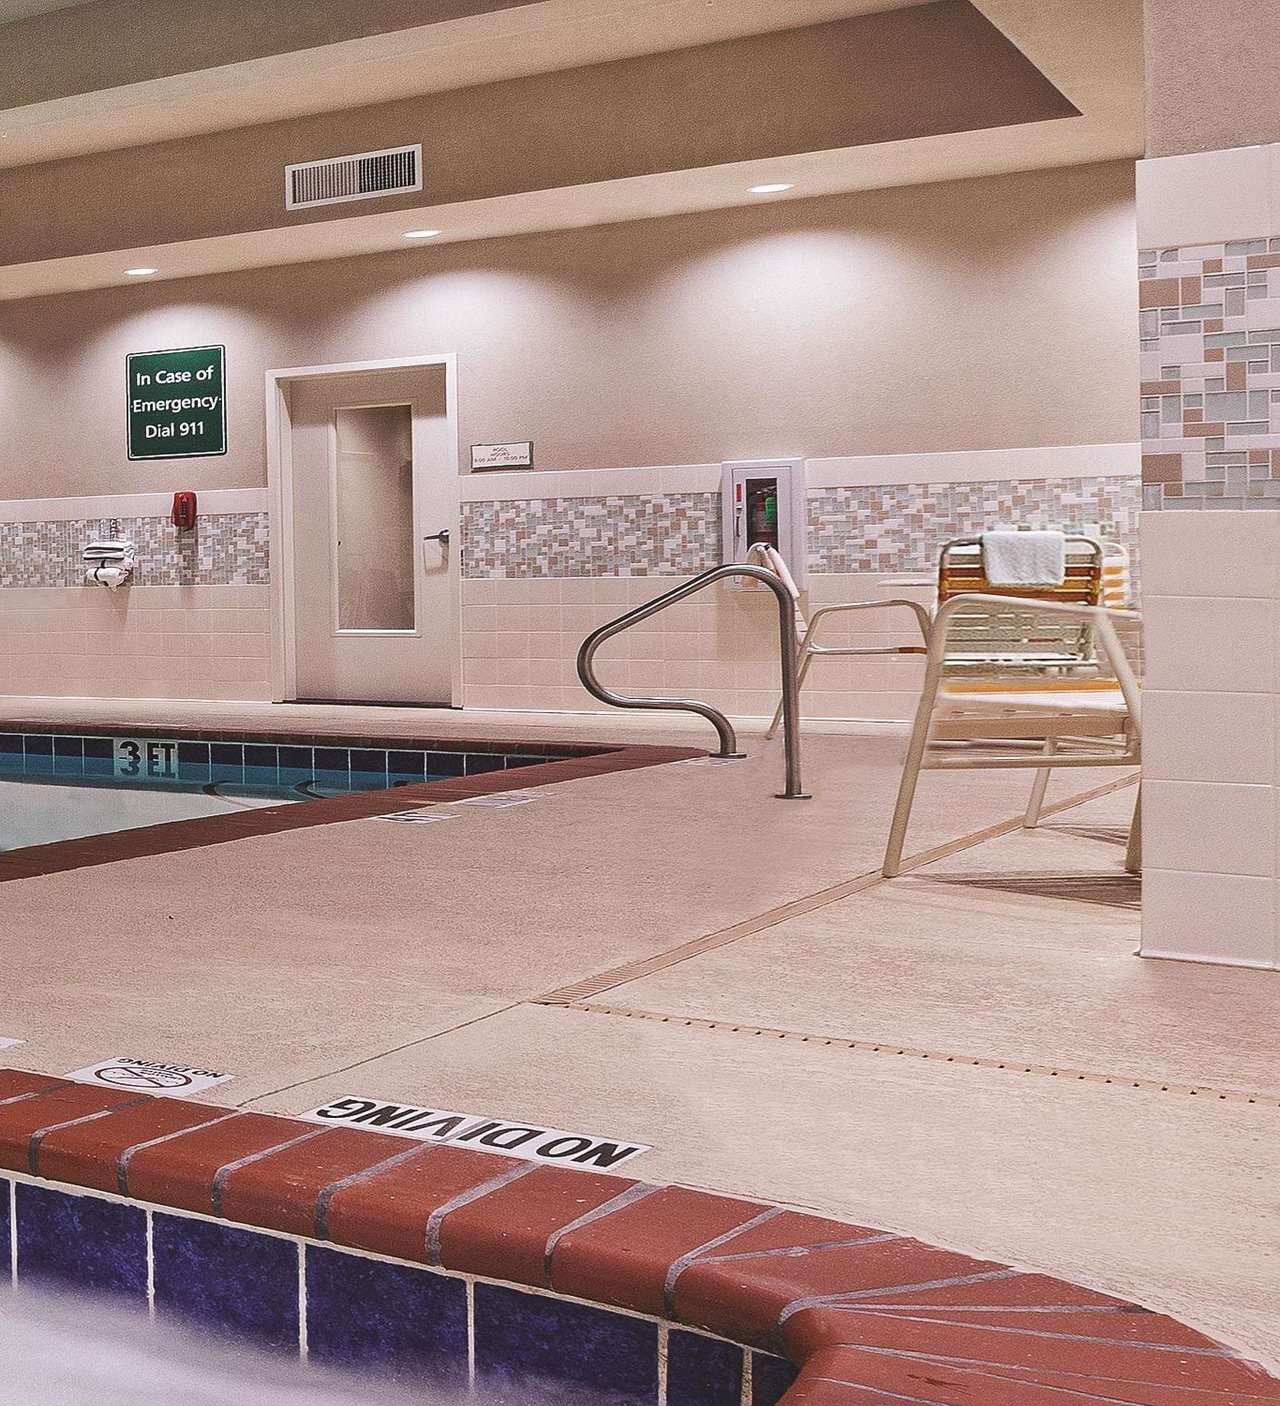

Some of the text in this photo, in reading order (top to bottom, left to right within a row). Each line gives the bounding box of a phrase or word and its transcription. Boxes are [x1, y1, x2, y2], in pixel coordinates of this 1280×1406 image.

[136, 365, 214, 386] In Case of
[133, 396, 218, 413] Emergency
[145, 421, 204, 438] Dial 911
[116, 1057, 192, 1074] DIVING
[191, 1069, 224, 1079] NO
[316, 1098, 640, 1168] NO DIVING
